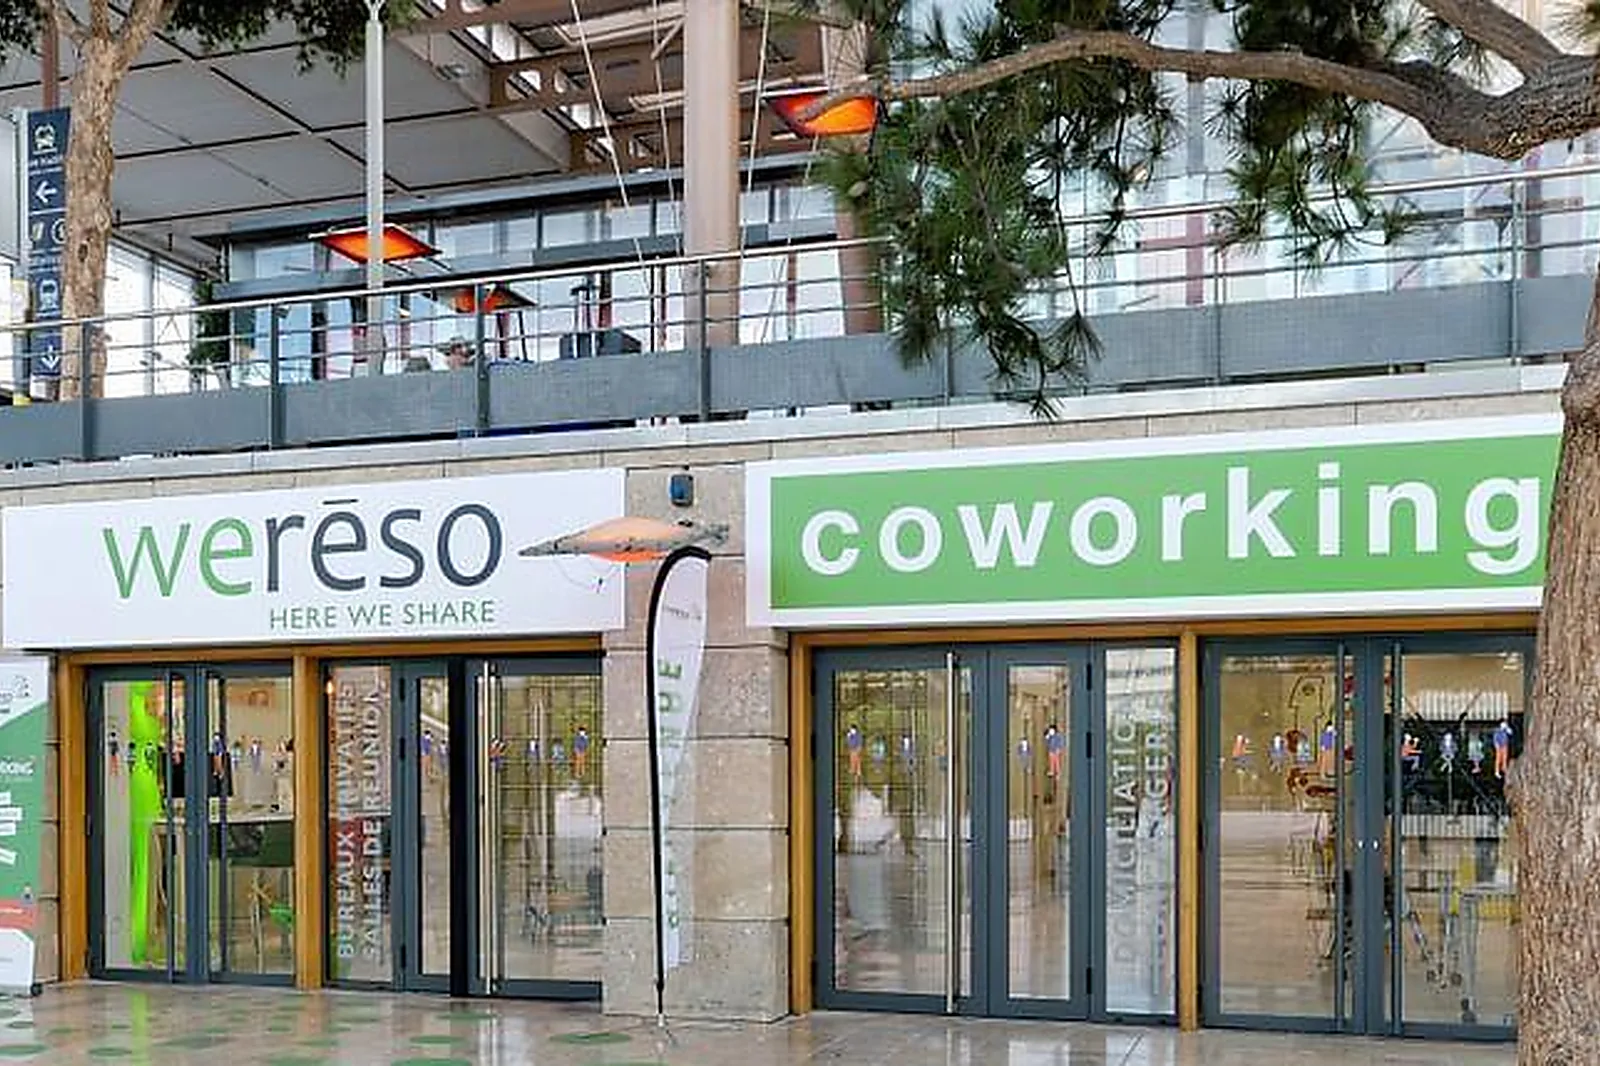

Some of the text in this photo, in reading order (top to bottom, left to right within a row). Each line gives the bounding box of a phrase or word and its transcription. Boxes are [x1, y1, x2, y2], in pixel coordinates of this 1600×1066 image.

[800, 462, 1542, 577] coworking
[270, 600, 495, 630] HERE WE SHARE
[361, 820, 382, 856] DE
[336, 831, 355, 959] BUREAUX
[361, 865, 382, 960] SALLES
